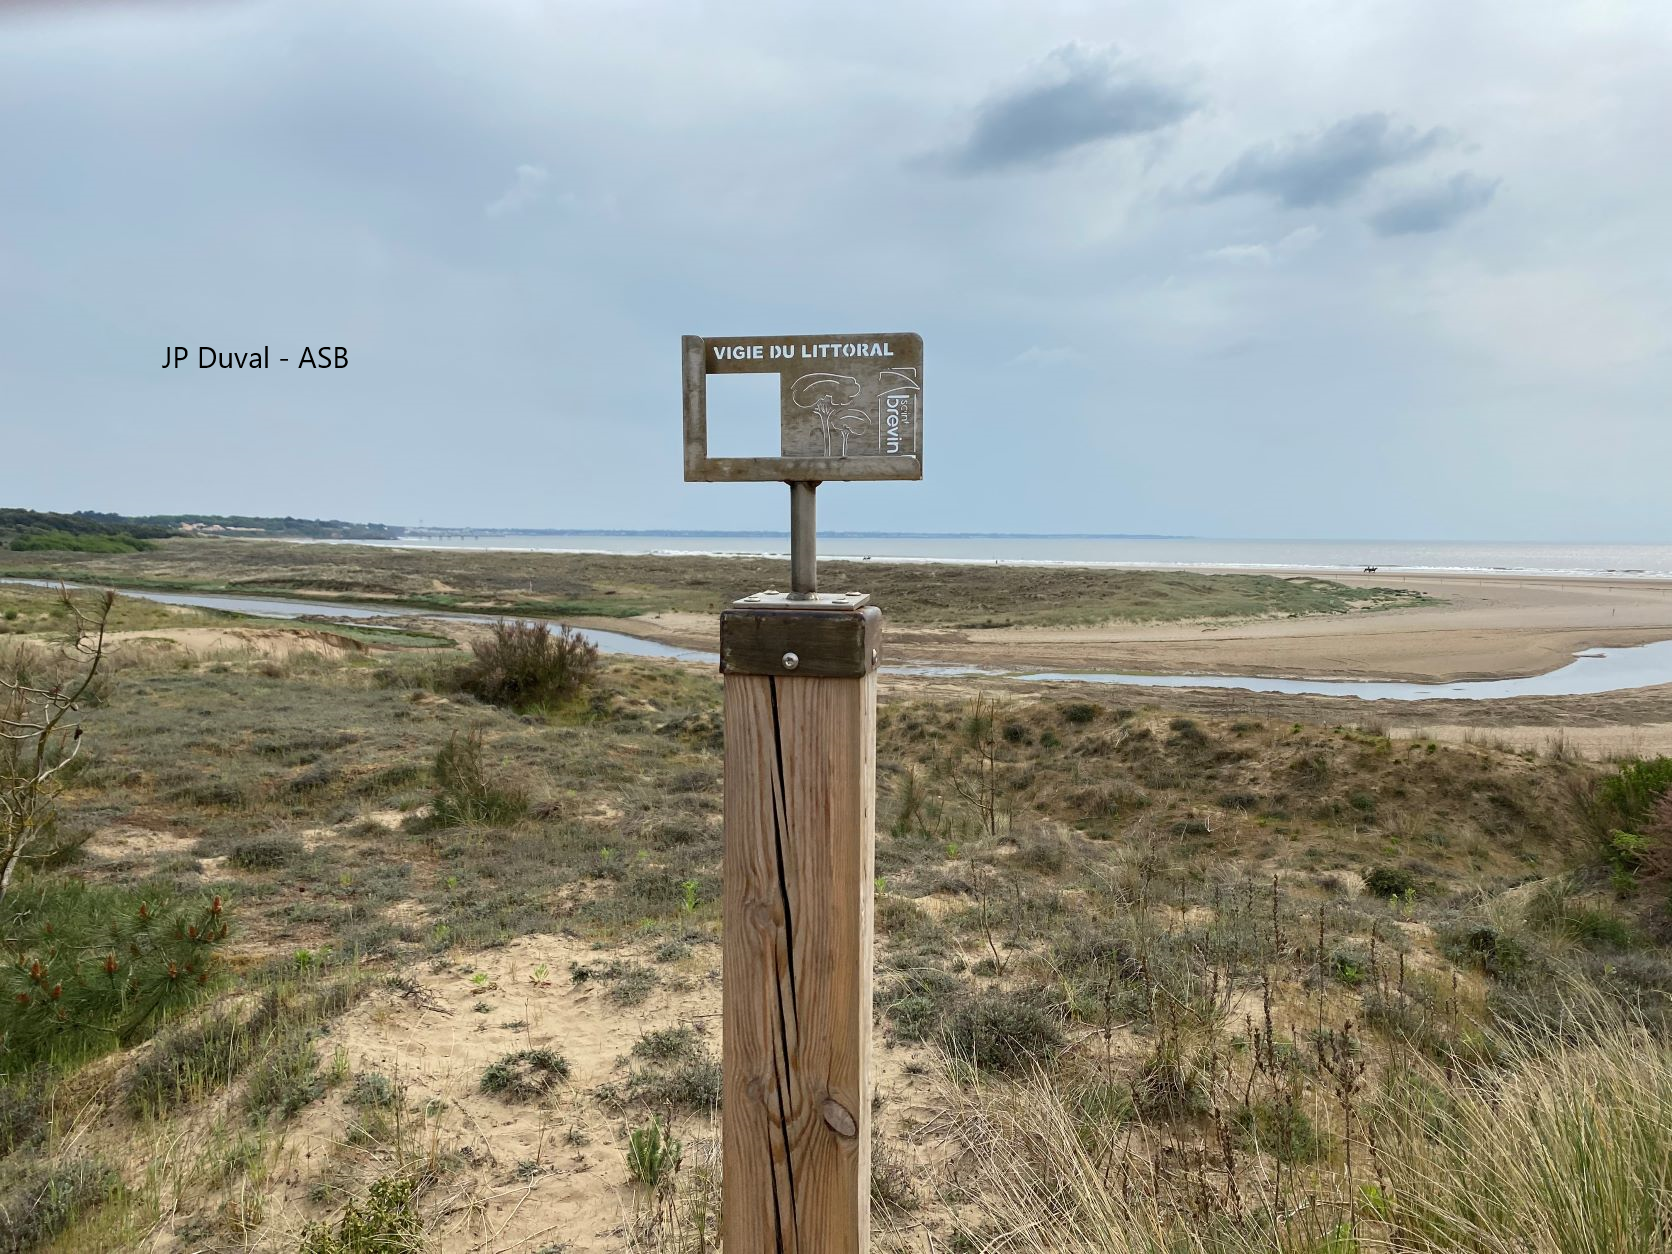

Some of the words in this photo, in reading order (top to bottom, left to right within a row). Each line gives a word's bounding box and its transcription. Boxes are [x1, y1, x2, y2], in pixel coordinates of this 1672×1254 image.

[713, 345, 764, 360] VIGIE
[769, 345, 795, 359] DU
[801, 343, 894, 359] LITTORAL
[886, 394, 910, 454] brevin
